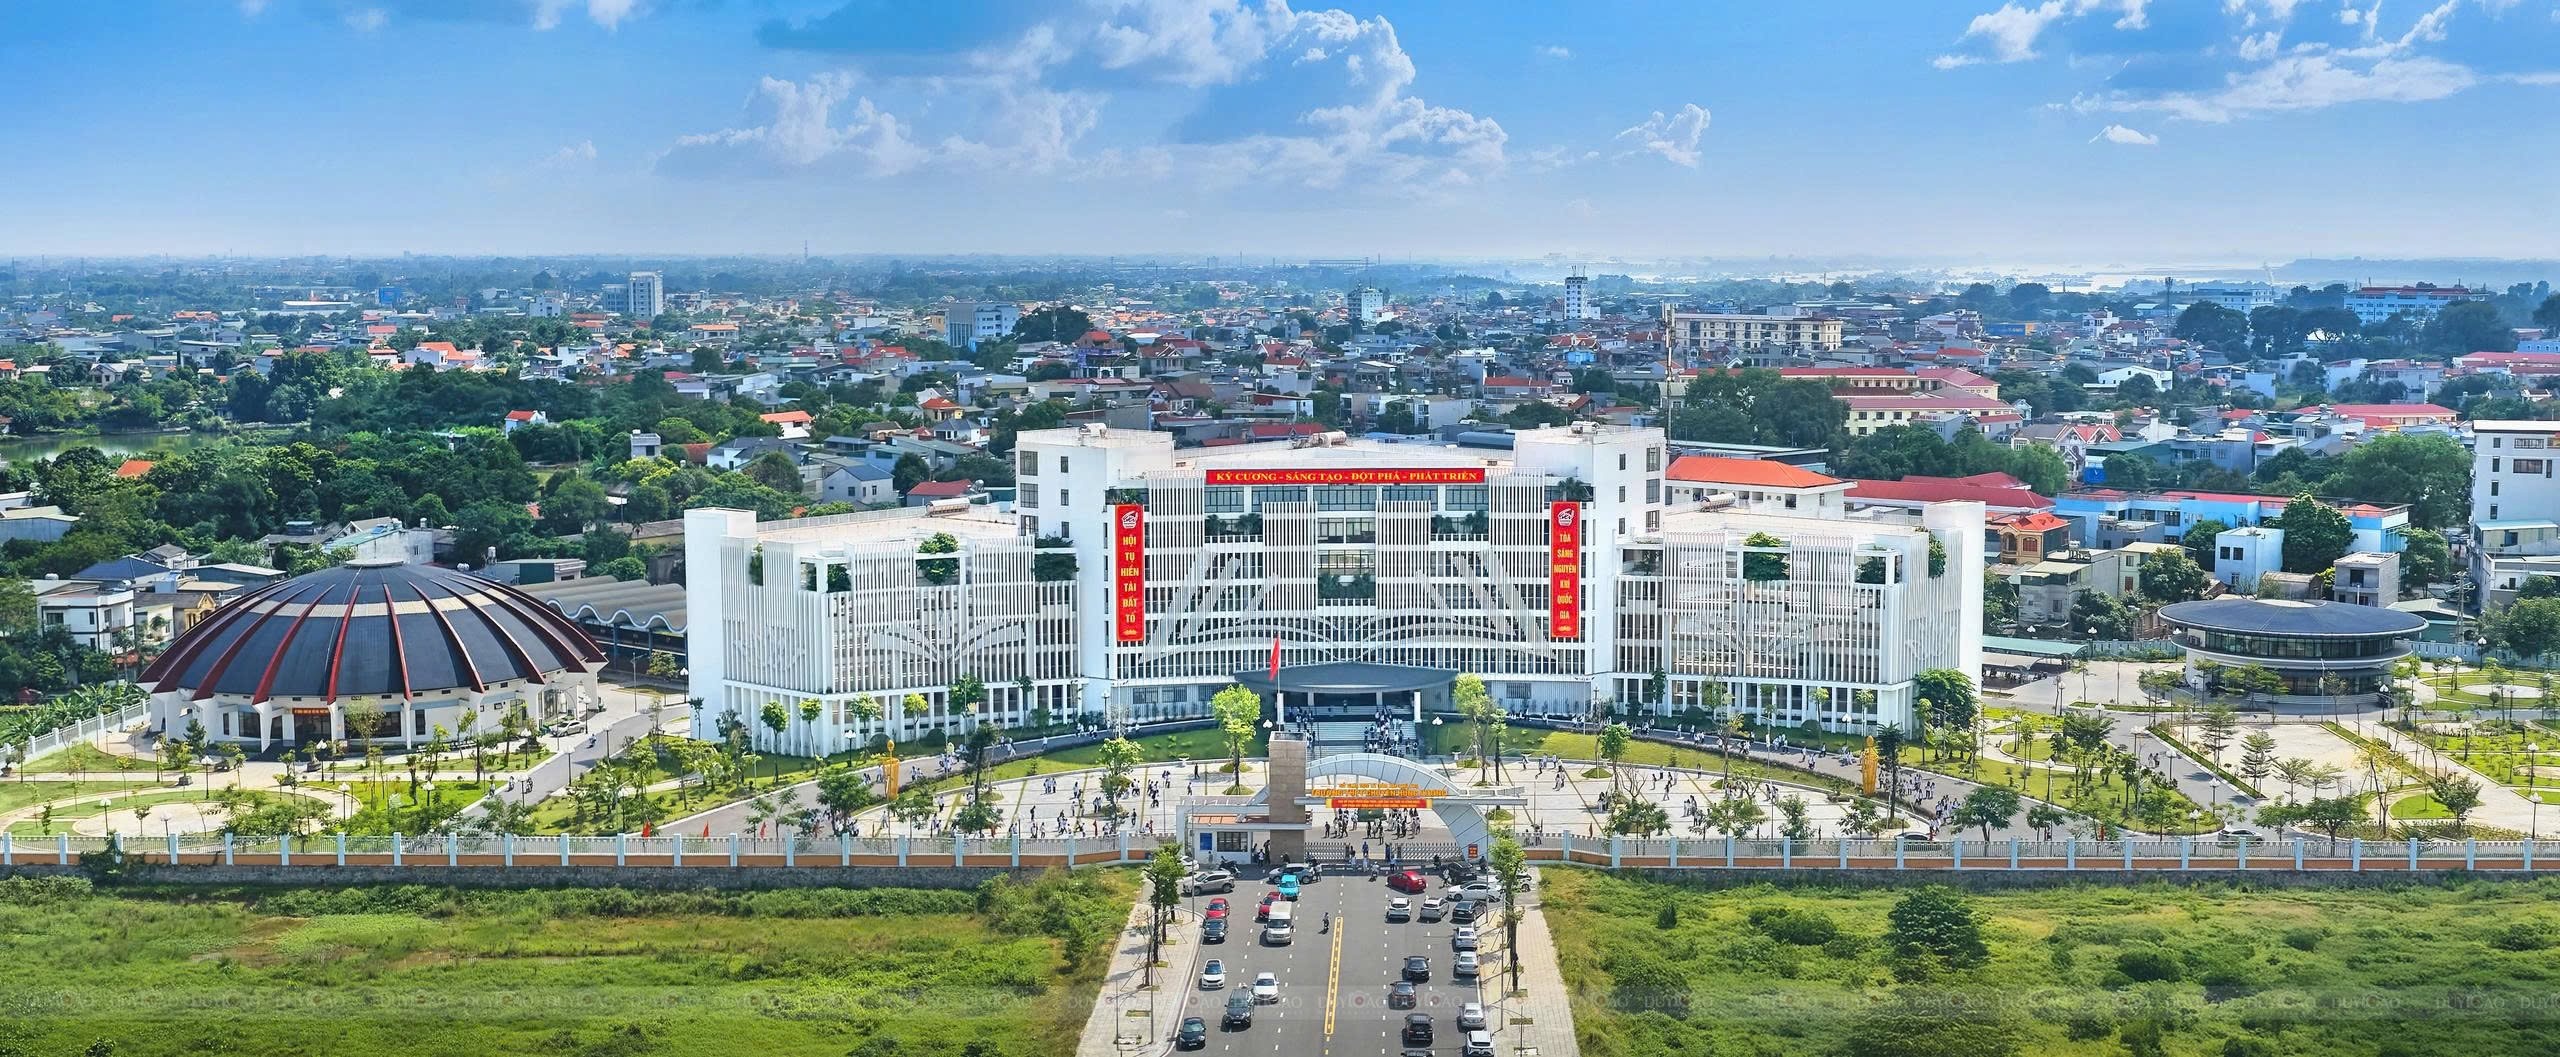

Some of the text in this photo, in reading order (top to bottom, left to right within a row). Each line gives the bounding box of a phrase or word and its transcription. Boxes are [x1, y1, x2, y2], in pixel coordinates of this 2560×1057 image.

[1236, 472, 1277, 481] CƯƠNG
[1286, 472, 1316, 481] SÁNG
[1319, 473, 1343, 483] TẠO
[1351, 471, 1376, 482] ĐỘT
[1378, 471, 1401, 481] PHÁ
[1410, 471, 1440, 481] PHÁT
[1442, 471, 1477, 481] TRIỂN
[1123, 535, 1136, 547] HỘI
[1125, 552, 1135, 562] TỤ
[1557, 547, 1574, 558] SÁNG
[1553, 563, 1577, 574] NGUYÊN
[1124, 581, 1136, 592] TÀI
[1123, 596, 1137, 608] ĐẤT
[1557, 592, 1573, 605] QUỐC
[1559, 610, 1570, 620] GIA
